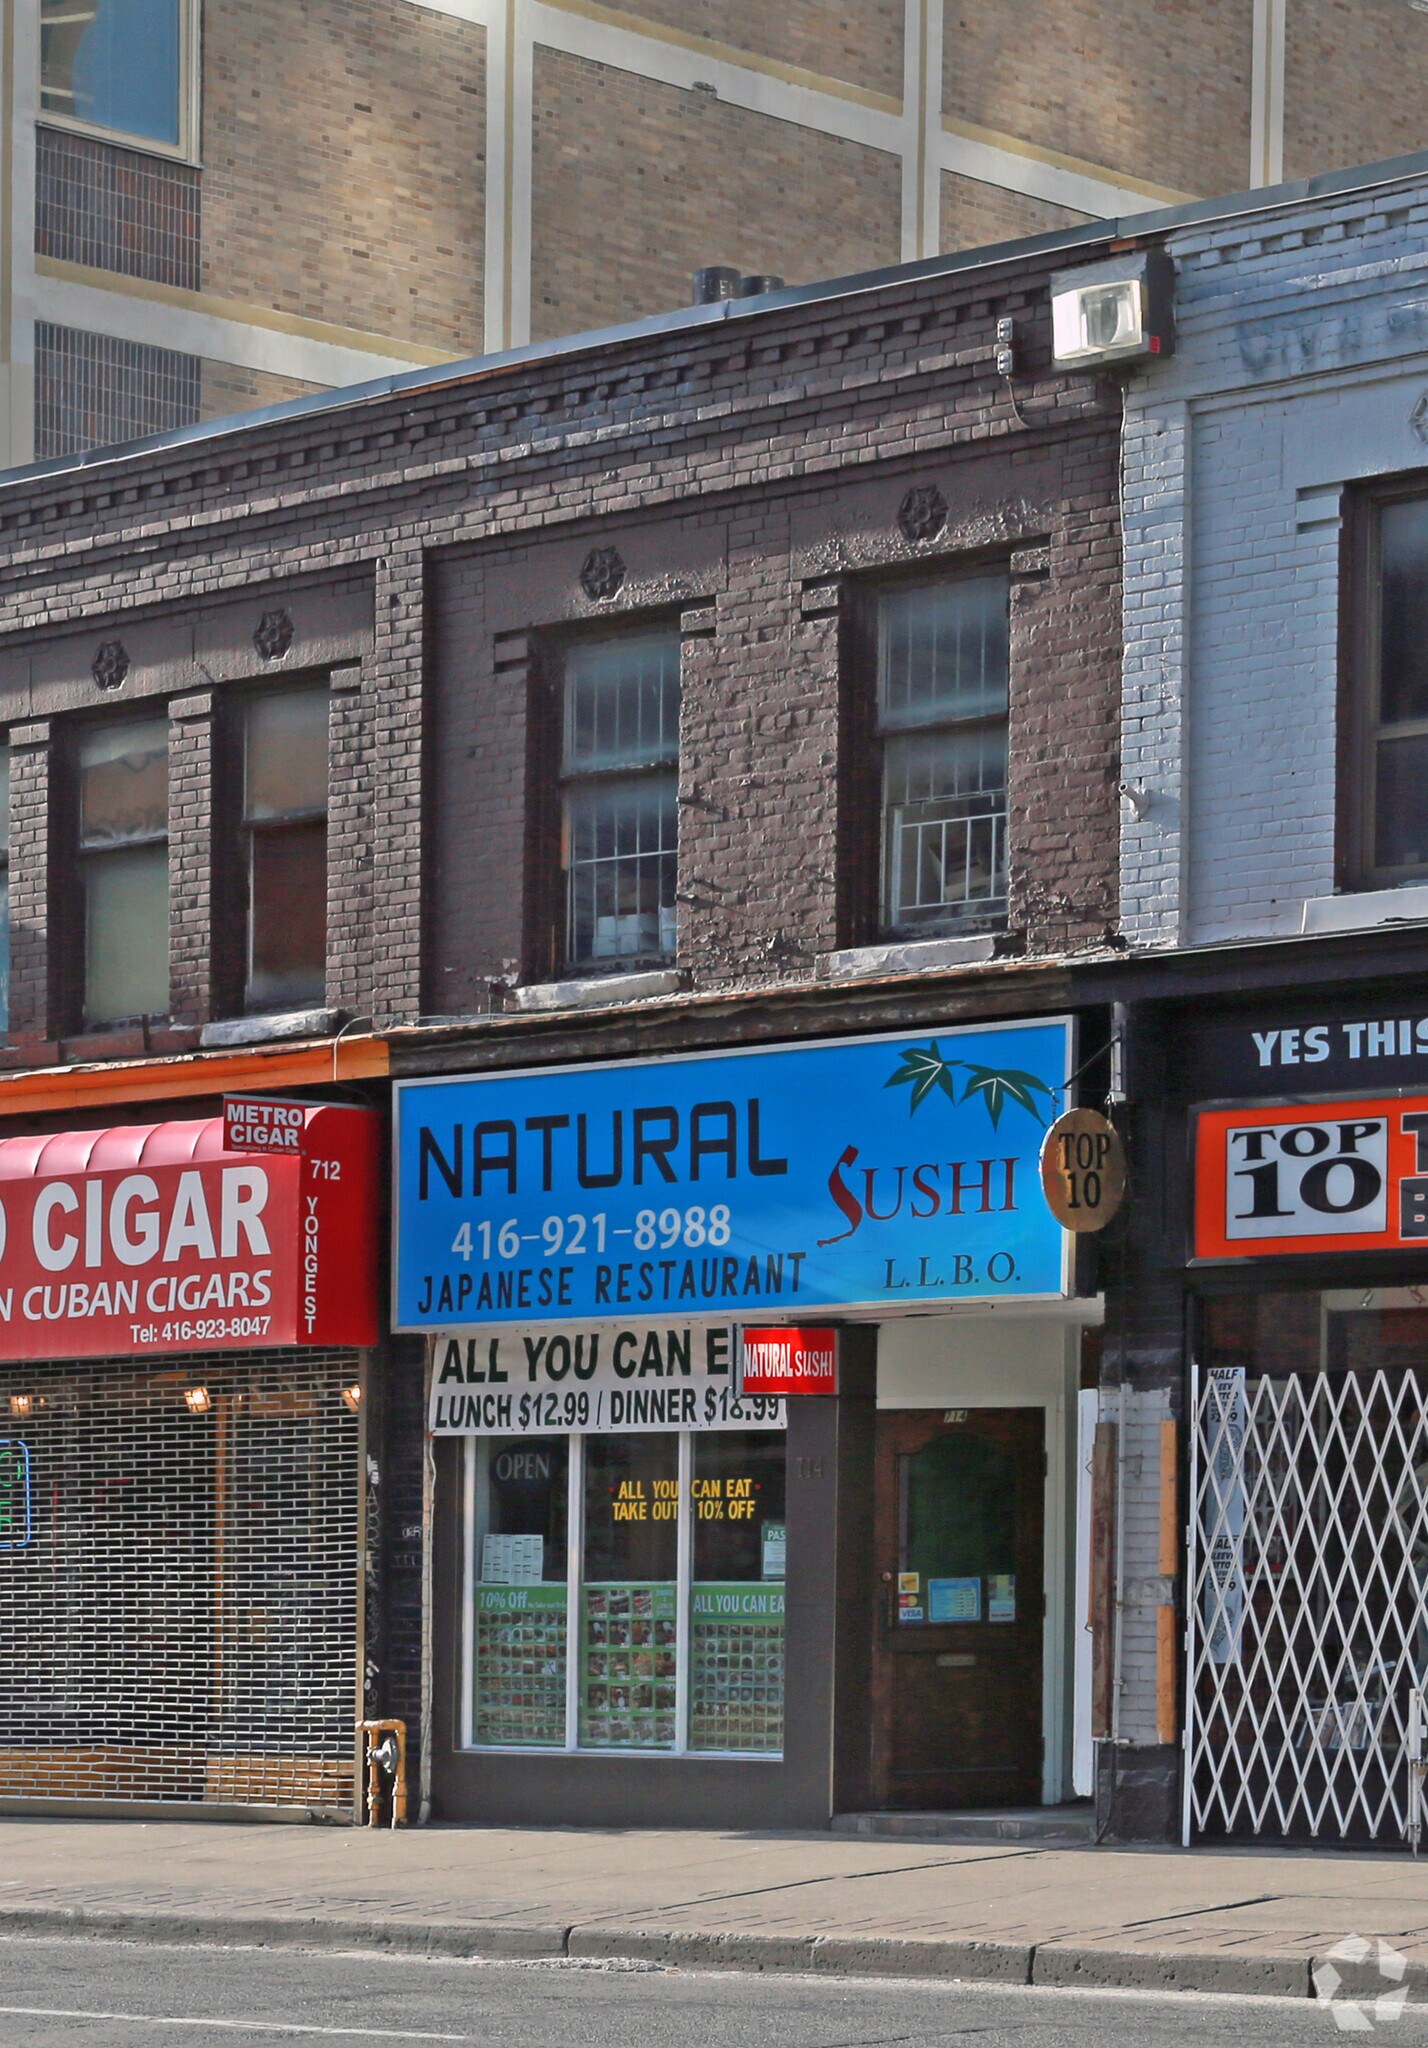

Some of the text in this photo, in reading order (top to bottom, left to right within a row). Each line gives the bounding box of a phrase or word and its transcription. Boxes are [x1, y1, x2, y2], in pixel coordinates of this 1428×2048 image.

[1252, 1026, 1330, 1067] YES
[227, 1104, 303, 1127] METRO
[230, 1125, 299, 1146] CIGAR
[419, 1098, 788, 1200] NATURAL
[1059, 1132, 1111, 1170] TOP
[1232, 1121, 1382, 1162] TOP
[311, 1159, 341, 1180] 712
[1234, 1157, 1381, 1219] 10
[817, 1145, 1020, 1248] SUSHI
[1068, 1172, 1100, 1209] 10
[32, 1165, 272, 1272] CIGAR
[451, 1204, 731, 1261] 416-921-8988
[304, 1197, 319, 1293] YONGE
[22, 1279, 138, 1321] CUBAN
[146, 1269, 272, 1313] CIGARS
[418, 1252, 806, 1314] JAPANESE RESTAURANT
[130, 1315, 272, 1344] Tel: 416-923-8047
[438, 1337, 508, 1385] ALL
[523, 1333, 598, 1383] YOU
[612, 1329, 692, 1379] CAN
[744, 1343, 833, 1378] NATURAL SUSHI
[435, 1393, 512, 1429] LUNCH
[518, 1391, 590, 1431] $12.99
[611, 1388, 697, 1425] DINNER
[496, 1453, 550, 1481] OPEN
[618, 1478, 752, 1499] ALL YOU CAN EAT
[613, 1500, 756, 1521] TAKE OUT 10% OFF
[480, 1590, 529, 1609] 10% Off
[693, 1594, 714, 1613] ALL
[716, 1594, 740, 1614] YOU
[742, 1594, 767, 1614] CAN
[902, 1609, 922, 1618] VISA
